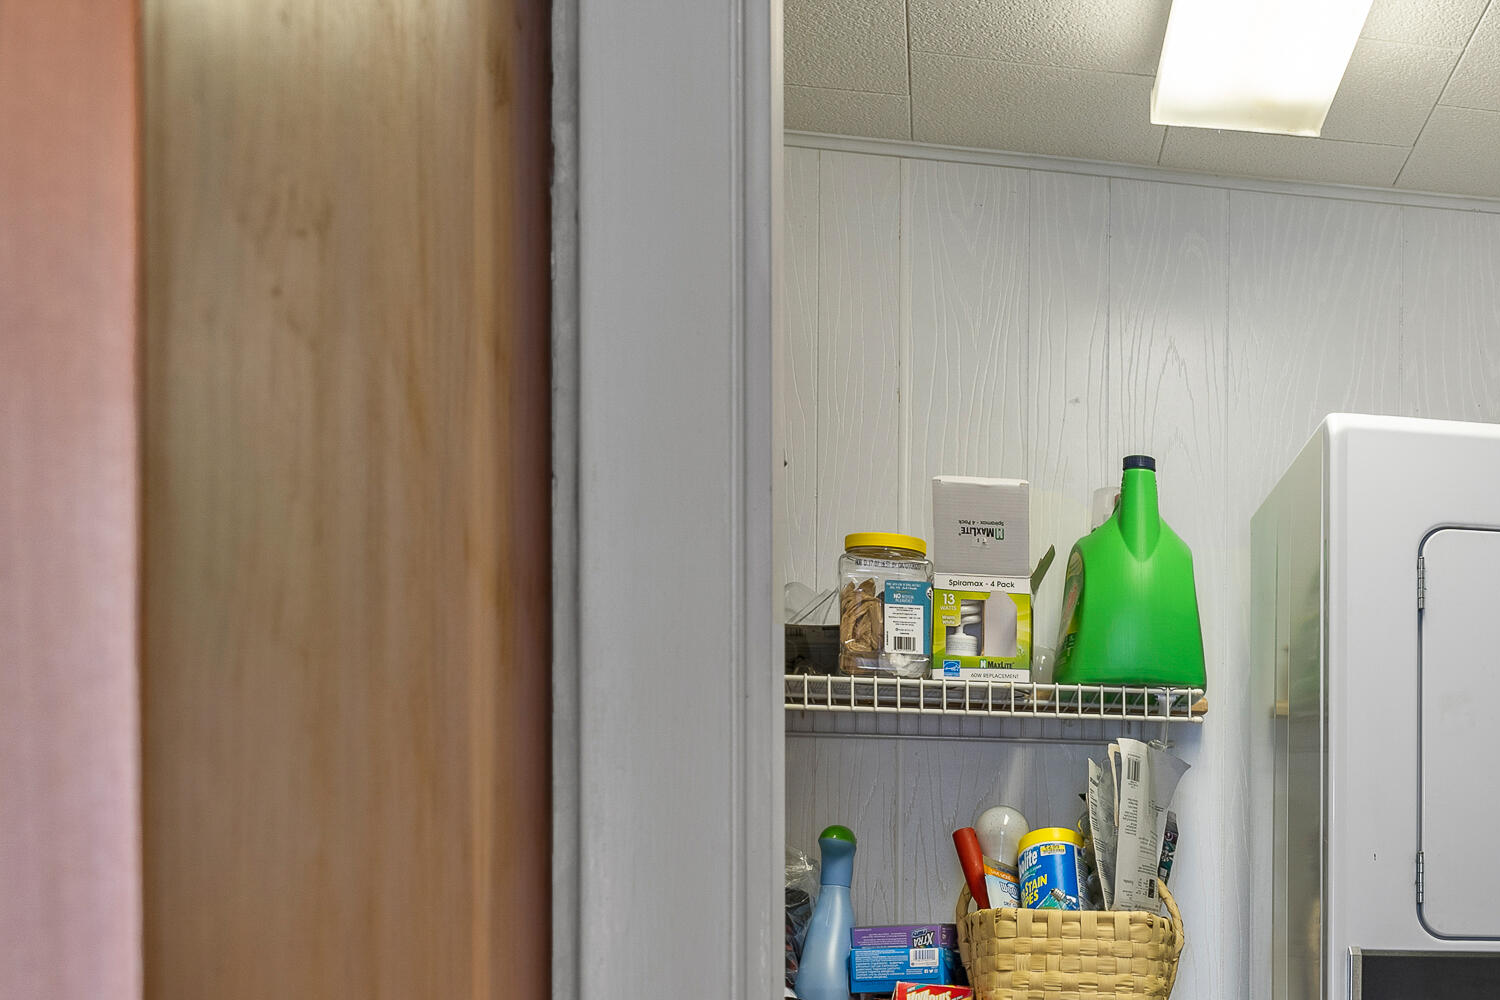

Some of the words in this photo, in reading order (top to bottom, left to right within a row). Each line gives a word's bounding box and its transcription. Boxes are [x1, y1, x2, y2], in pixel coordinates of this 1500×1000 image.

[948, 579, 984, 588] Spiramax
[943, 593, 955, 605] 13
[1025, 874, 1048, 897] STAIN
[913, 931, 934, 948] XTRA
